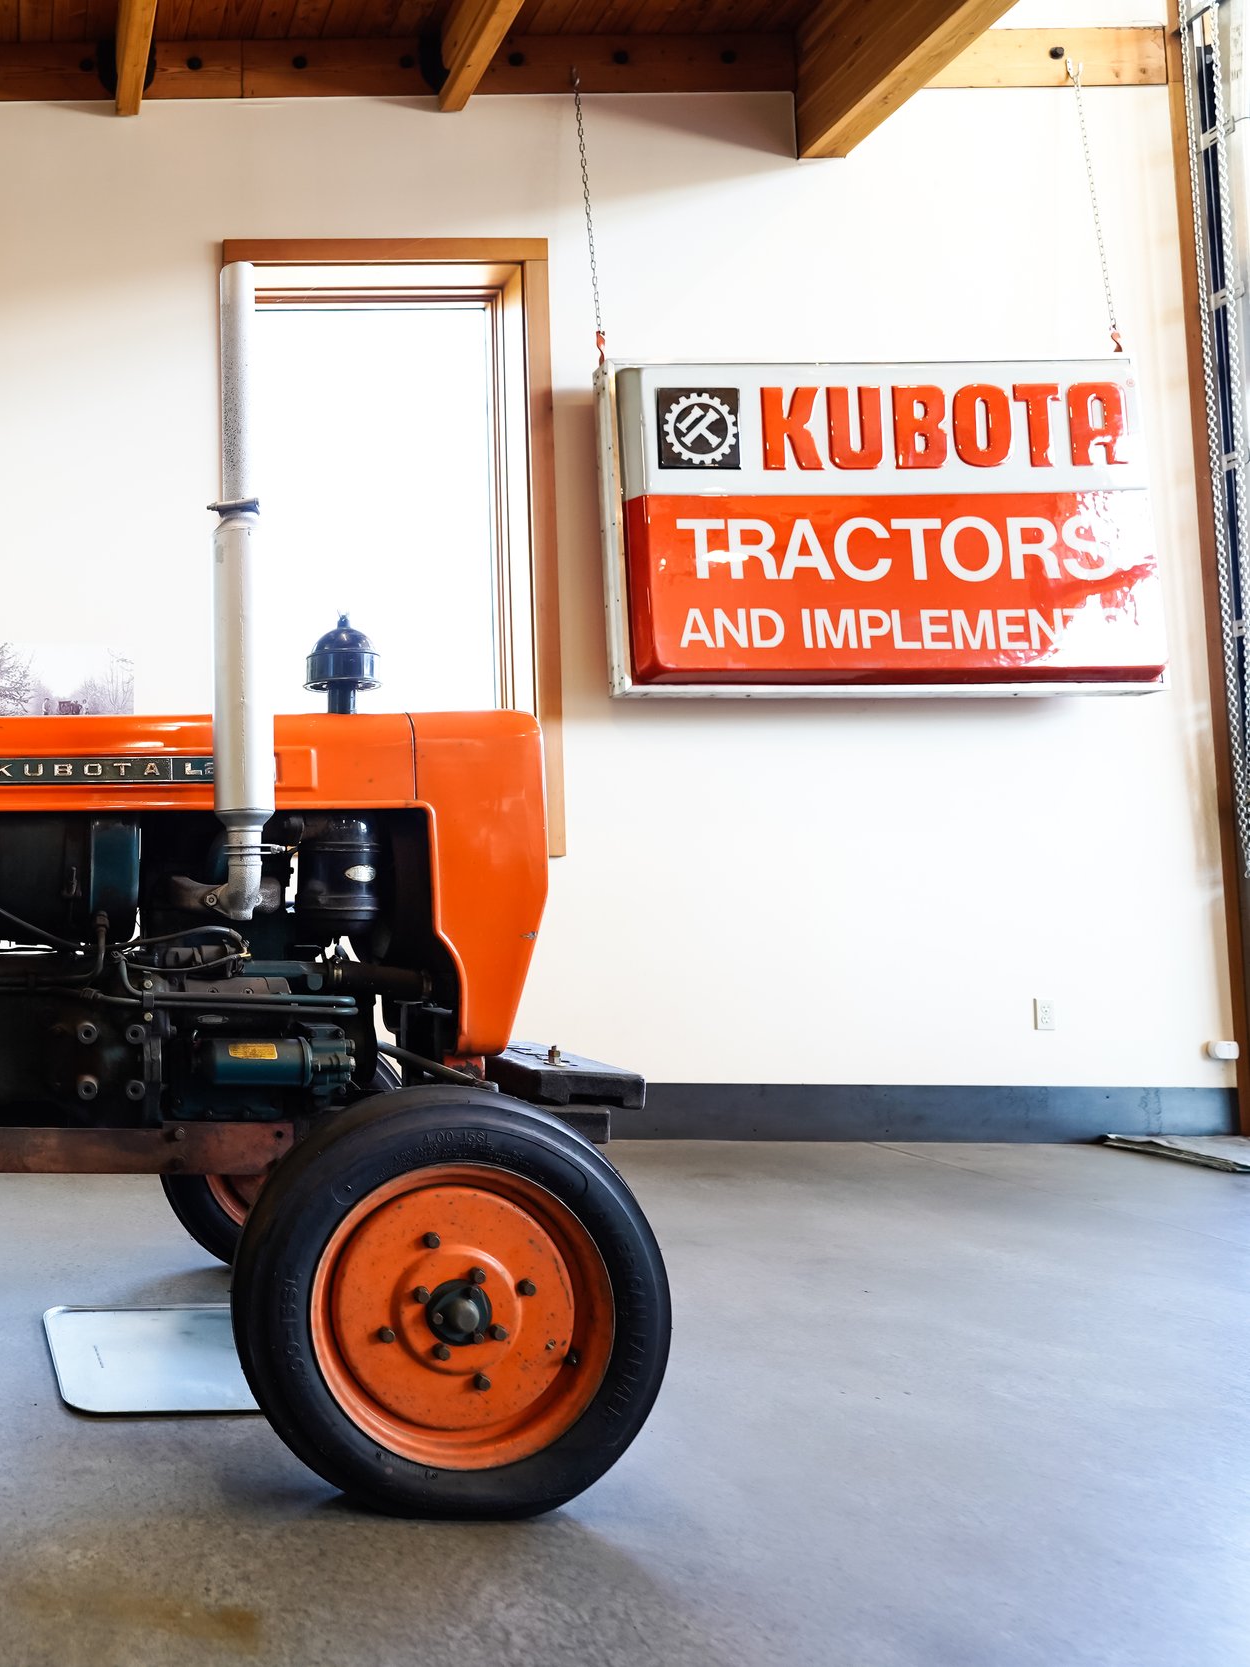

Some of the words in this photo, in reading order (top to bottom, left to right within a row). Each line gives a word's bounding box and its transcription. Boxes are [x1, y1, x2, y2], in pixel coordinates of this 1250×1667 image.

[760, 381, 1129, 471] KUBOTA
[676, 516, 1117, 582] TRACTORS
[680, 608, 785, 648] AND
[803, 608, 1120, 650] IMPLEMEN
